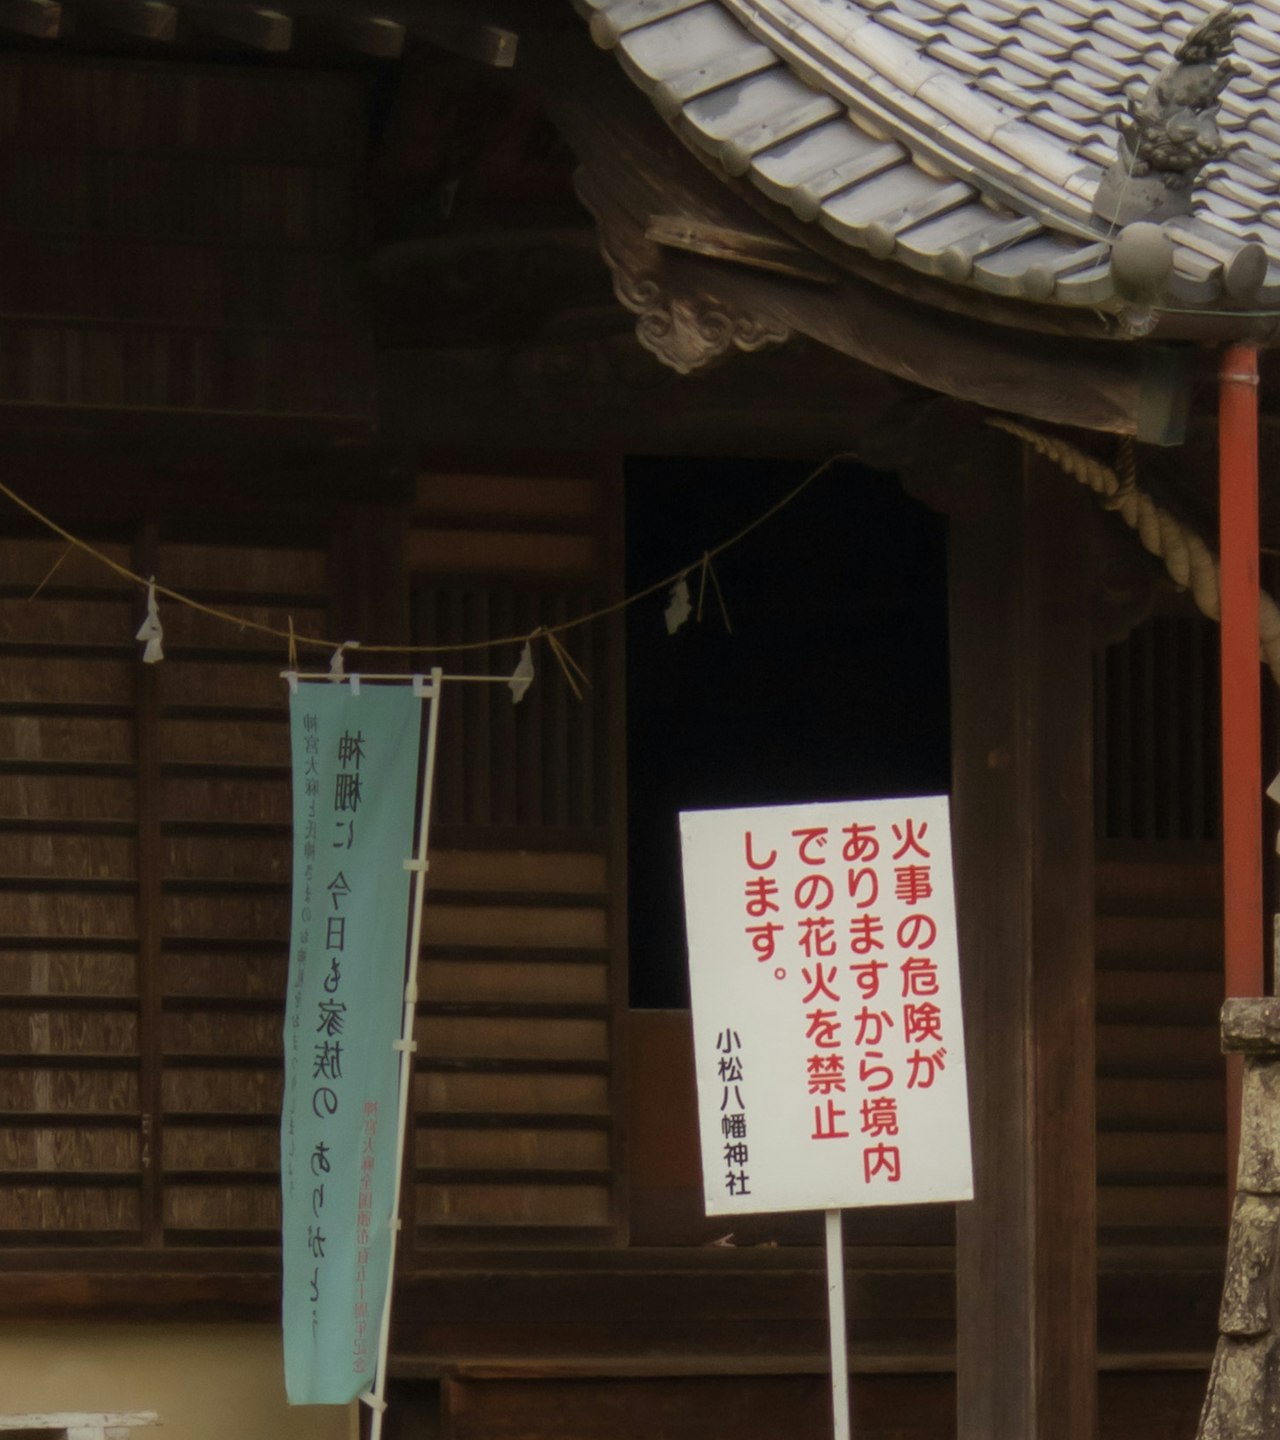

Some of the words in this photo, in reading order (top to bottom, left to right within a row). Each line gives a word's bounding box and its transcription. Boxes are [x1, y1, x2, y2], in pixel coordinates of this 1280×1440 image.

[744, 830, 787, 981] します。
[791, 826, 850, 1141] での花火を禁止
[841, 822, 902, 1184] ありますから境内
[891, 818, 947, 1090] 火事の危険が
[716, 1027, 751, 1196] 小松八幡神社
